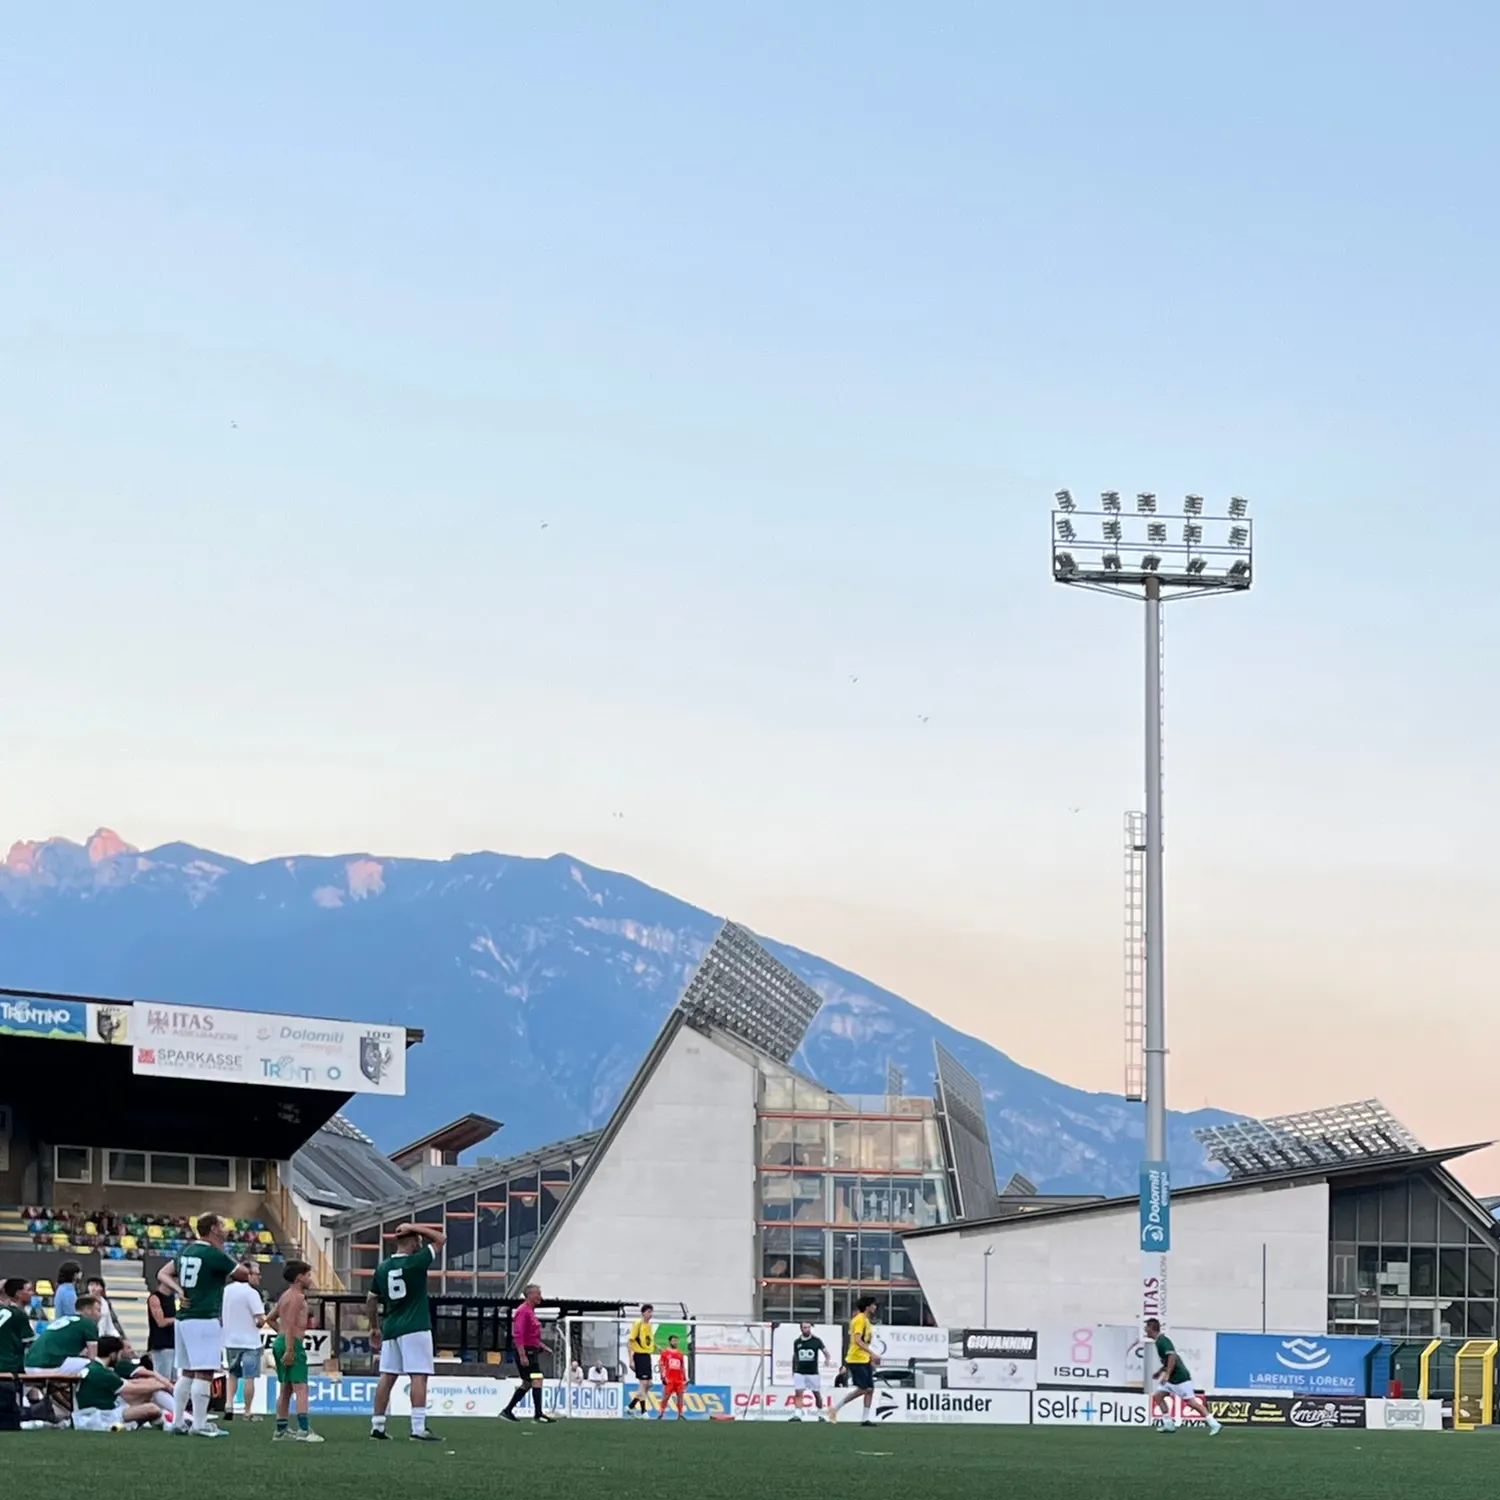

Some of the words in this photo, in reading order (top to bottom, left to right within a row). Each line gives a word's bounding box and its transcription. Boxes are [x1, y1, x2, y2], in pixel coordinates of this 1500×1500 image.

[172, 1012, 214, 1031] ITAS
[280, 1026, 344, 1043] Dolomiti
[158, 1048, 242, 1067] SPARKASSE
[1149, 1169, 1160, 1223] Dolomiti
[180, 1256, 202, 1288] 13
[387, 1268, 407, 1300] 6
[1143, 1277, 1159, 1316] ITAS
[1054, 1366, 1109, 1378] ISOLA
[1249, 1373, 1305, 1385] LARENTIS
[1309, 1375, 1356, 1387] LORENZ
[734, 1393, 777, 1407] CAF
[785, 1395, 832, 1408] ACI
[906, 1393, 993, 1412] Holländer
[1038, 1395, 1080, 1419] Self
[1099, 1401, 1146, 1424] Plus
